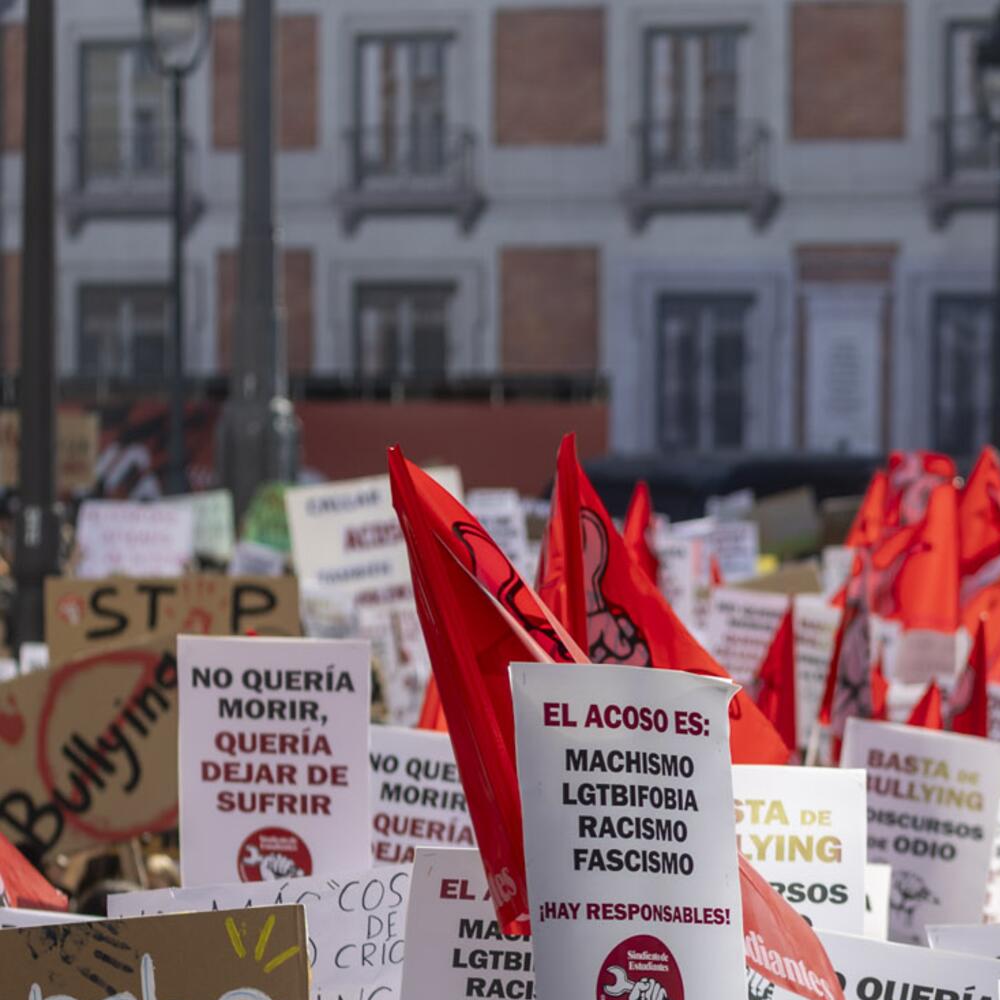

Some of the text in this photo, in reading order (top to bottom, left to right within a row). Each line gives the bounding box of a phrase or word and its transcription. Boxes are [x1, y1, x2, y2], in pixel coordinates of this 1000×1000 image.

[86, 583, 276, 640] STP
[191, 664, 355, 694] NO QUERÍA
[217, 699, 328, 726] MORIR,
[543, 702, 711, 738] EL ACOSO ES:
[214, 727, 332, 759] QUERÍA
[200, 761, 349, 788] DEJAR DE
[565, 748, 695, 779] MACHISMO
[867, 748, 950, 780] BASTA
[216, 790, 332, 817] SUFRIR
[561, 782, 699, 813] LGTBIFOBIA
[372, 812, 474, 846] QUERÍA
[578, 815, 688, 843] RACISMO
[800, 810, 832, 826] DE
[573, 848, 695, 876] FASCISMO
[893, 836, 957, 861] ODIO
[440, 879, 476, 900] EL
[366, 911, 398, 941] DE
[539, 902, 731, 927] ¡HAY RESPONSABLES!
[452, 948, 535, 973] LGTBI
[465, 978, 538, 1000] RACI
